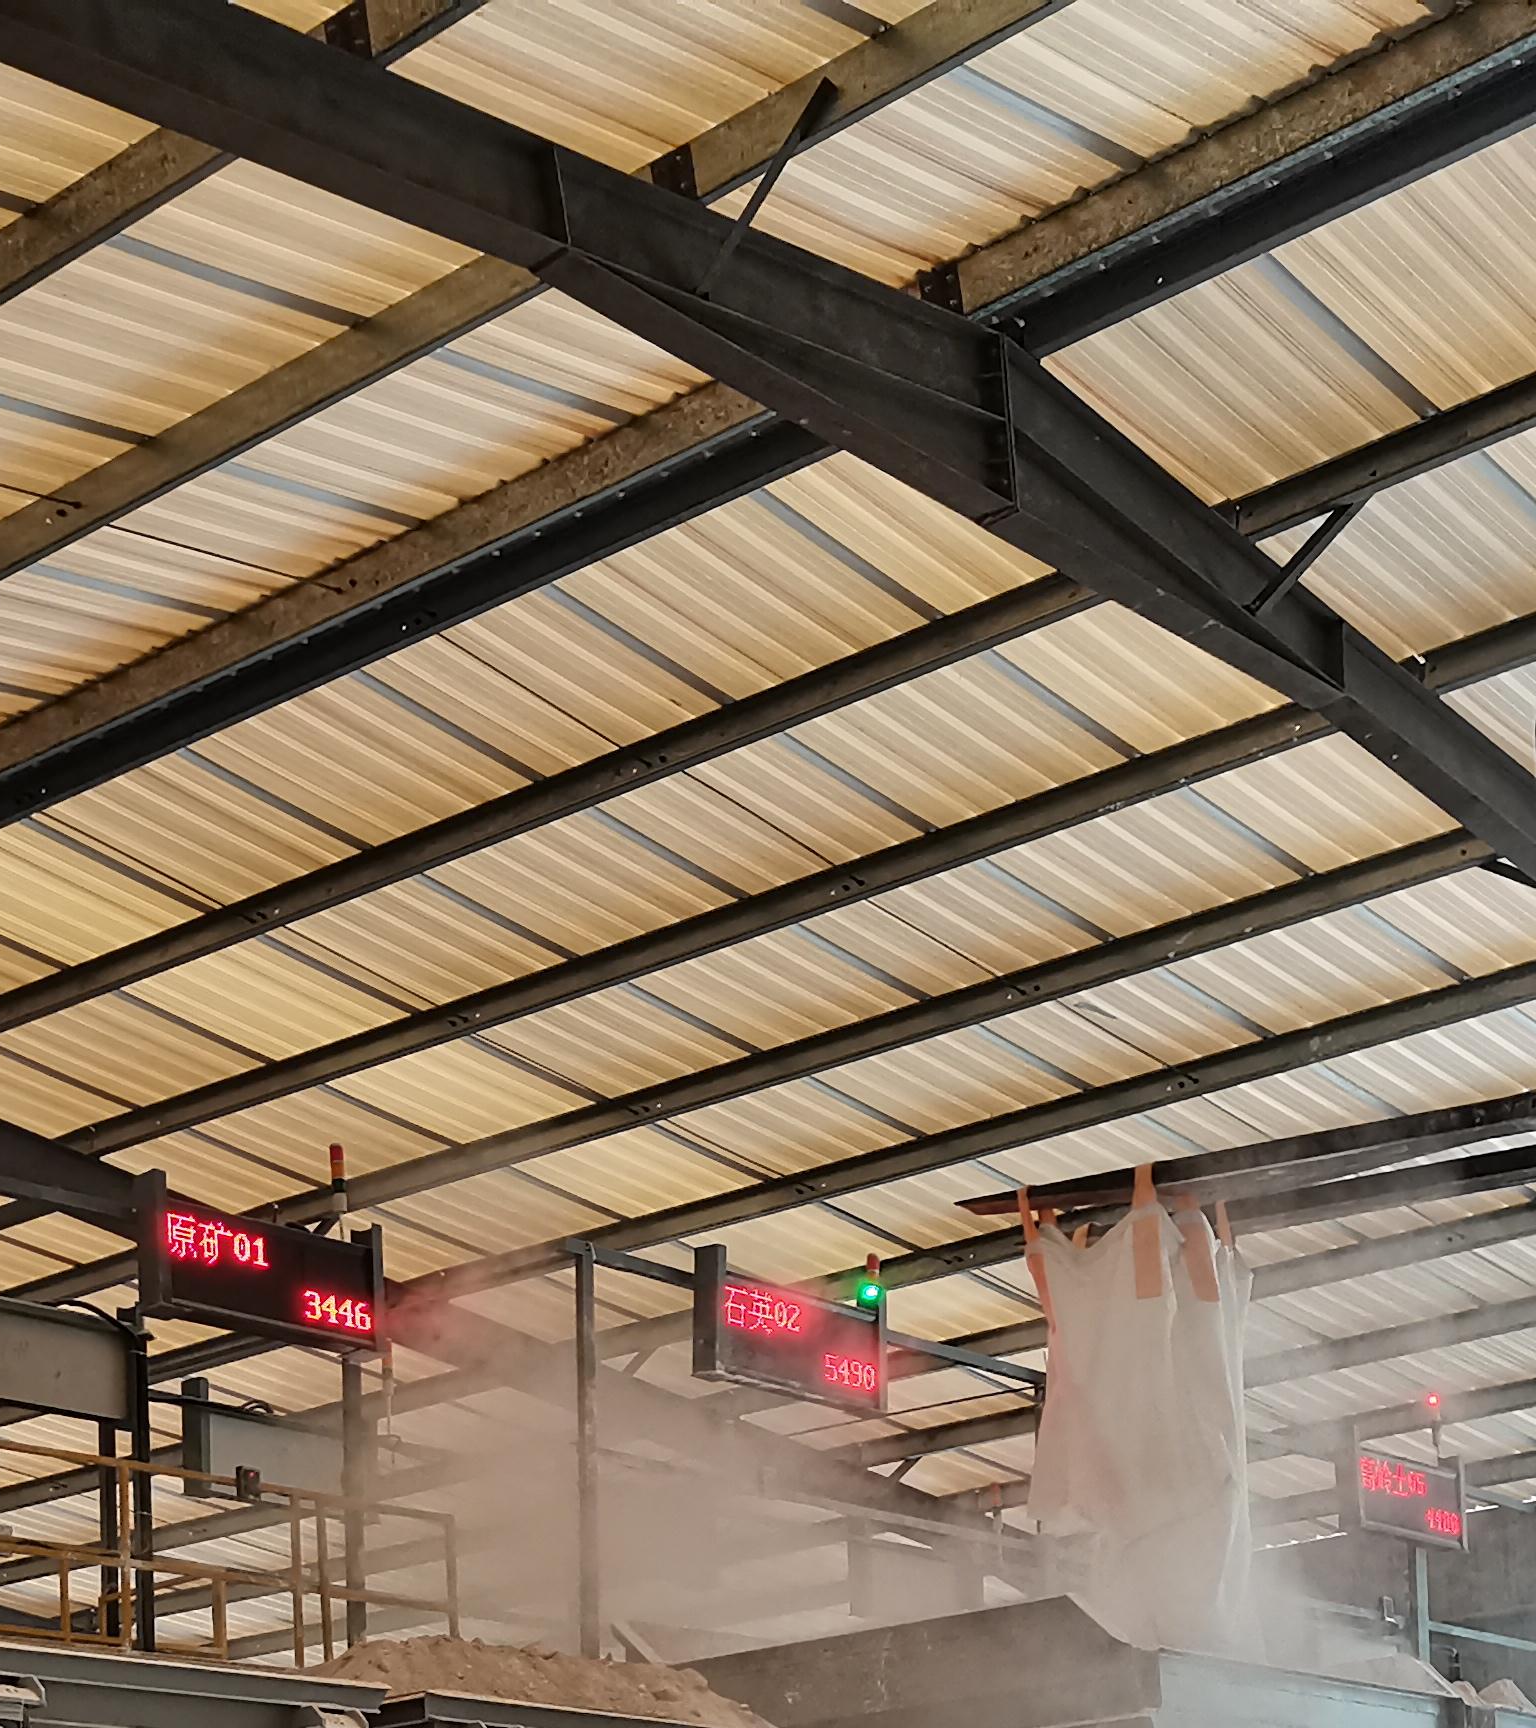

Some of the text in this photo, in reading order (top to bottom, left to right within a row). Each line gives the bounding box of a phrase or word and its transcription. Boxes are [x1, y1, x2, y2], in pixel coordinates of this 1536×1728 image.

[166, 1211, 269, 1267] 原矿01
[303, 1289, 373, 1331] 3446
[723, 1285, 802, 1335] 石英02
[824, 1353, 877, 1391] 5490
